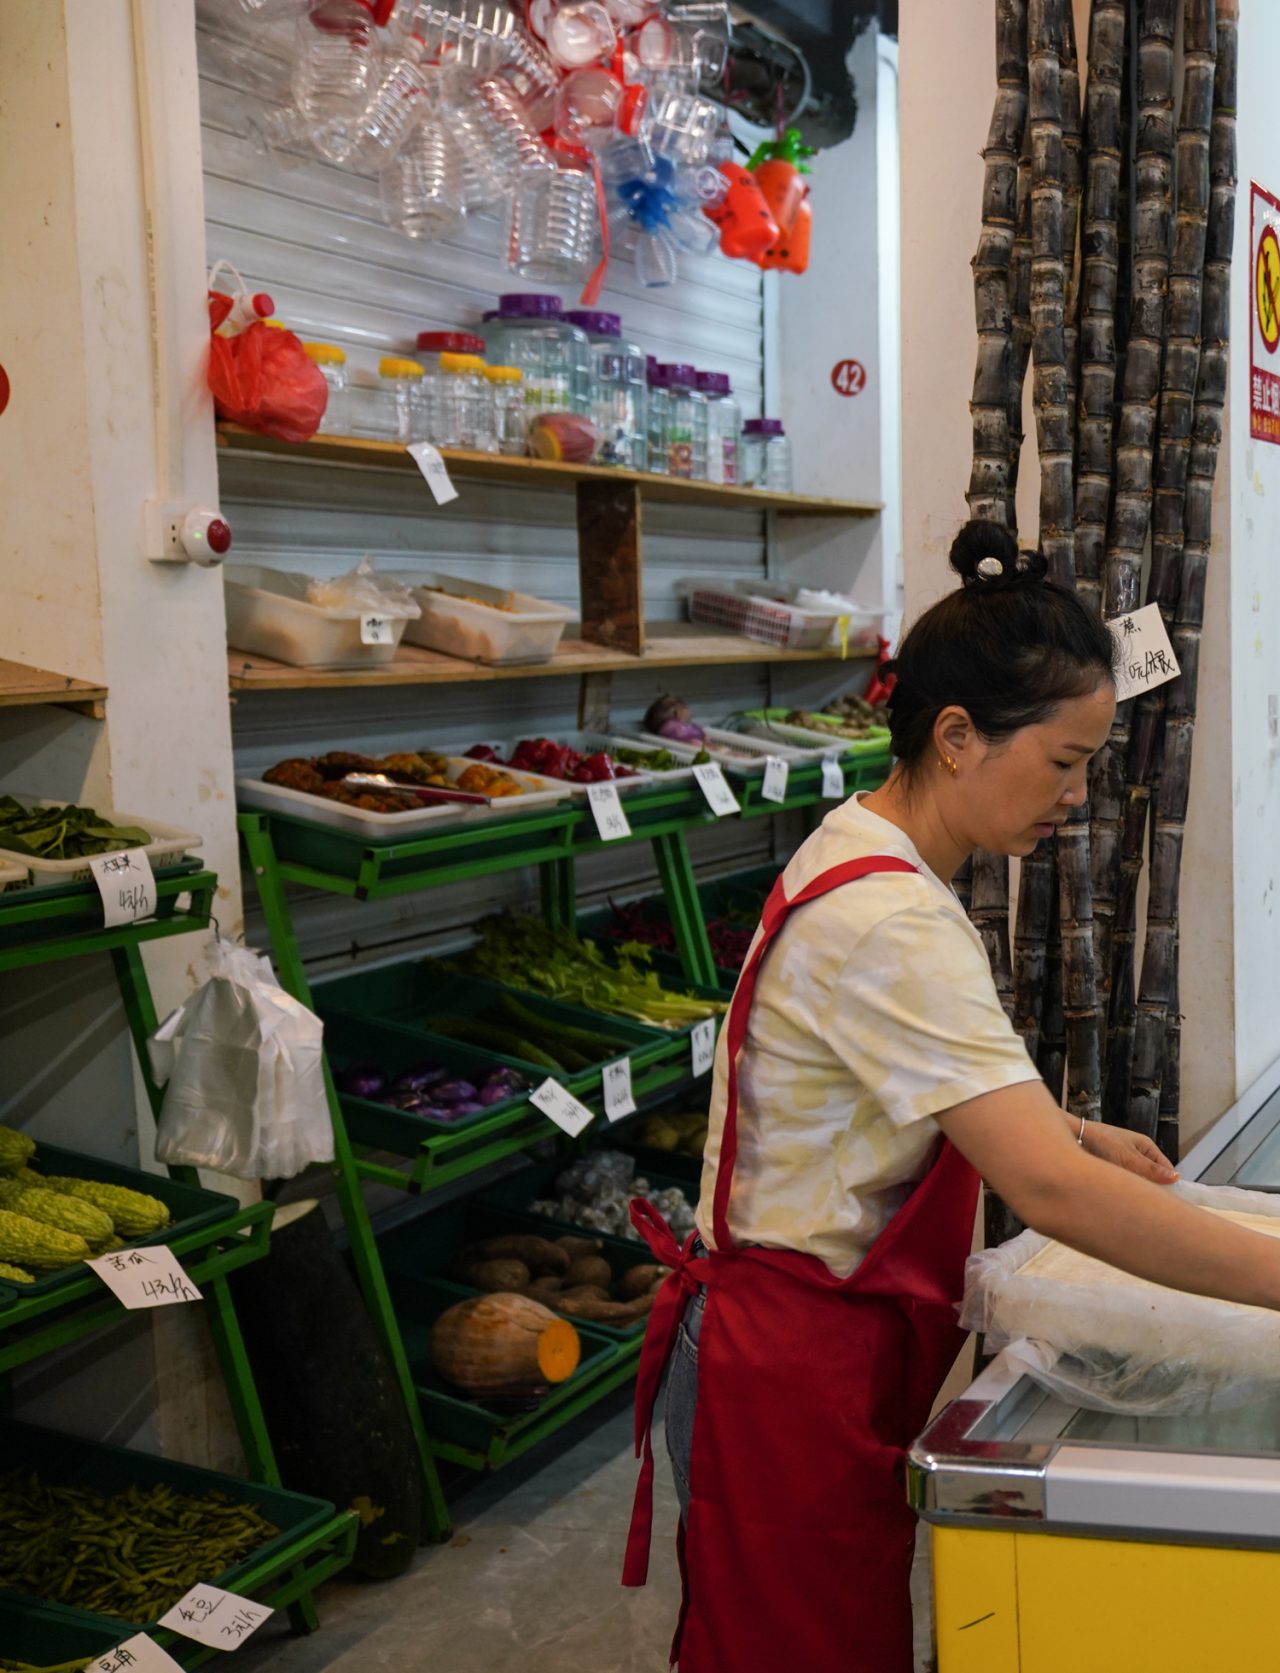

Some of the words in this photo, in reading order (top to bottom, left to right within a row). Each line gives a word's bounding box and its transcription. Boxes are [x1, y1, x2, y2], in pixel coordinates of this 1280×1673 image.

[836, 364, 862, 392] 42
[105, 1252, 158, 1271] 苦瓜
[99, 1647, 137, 1673] 豆角
